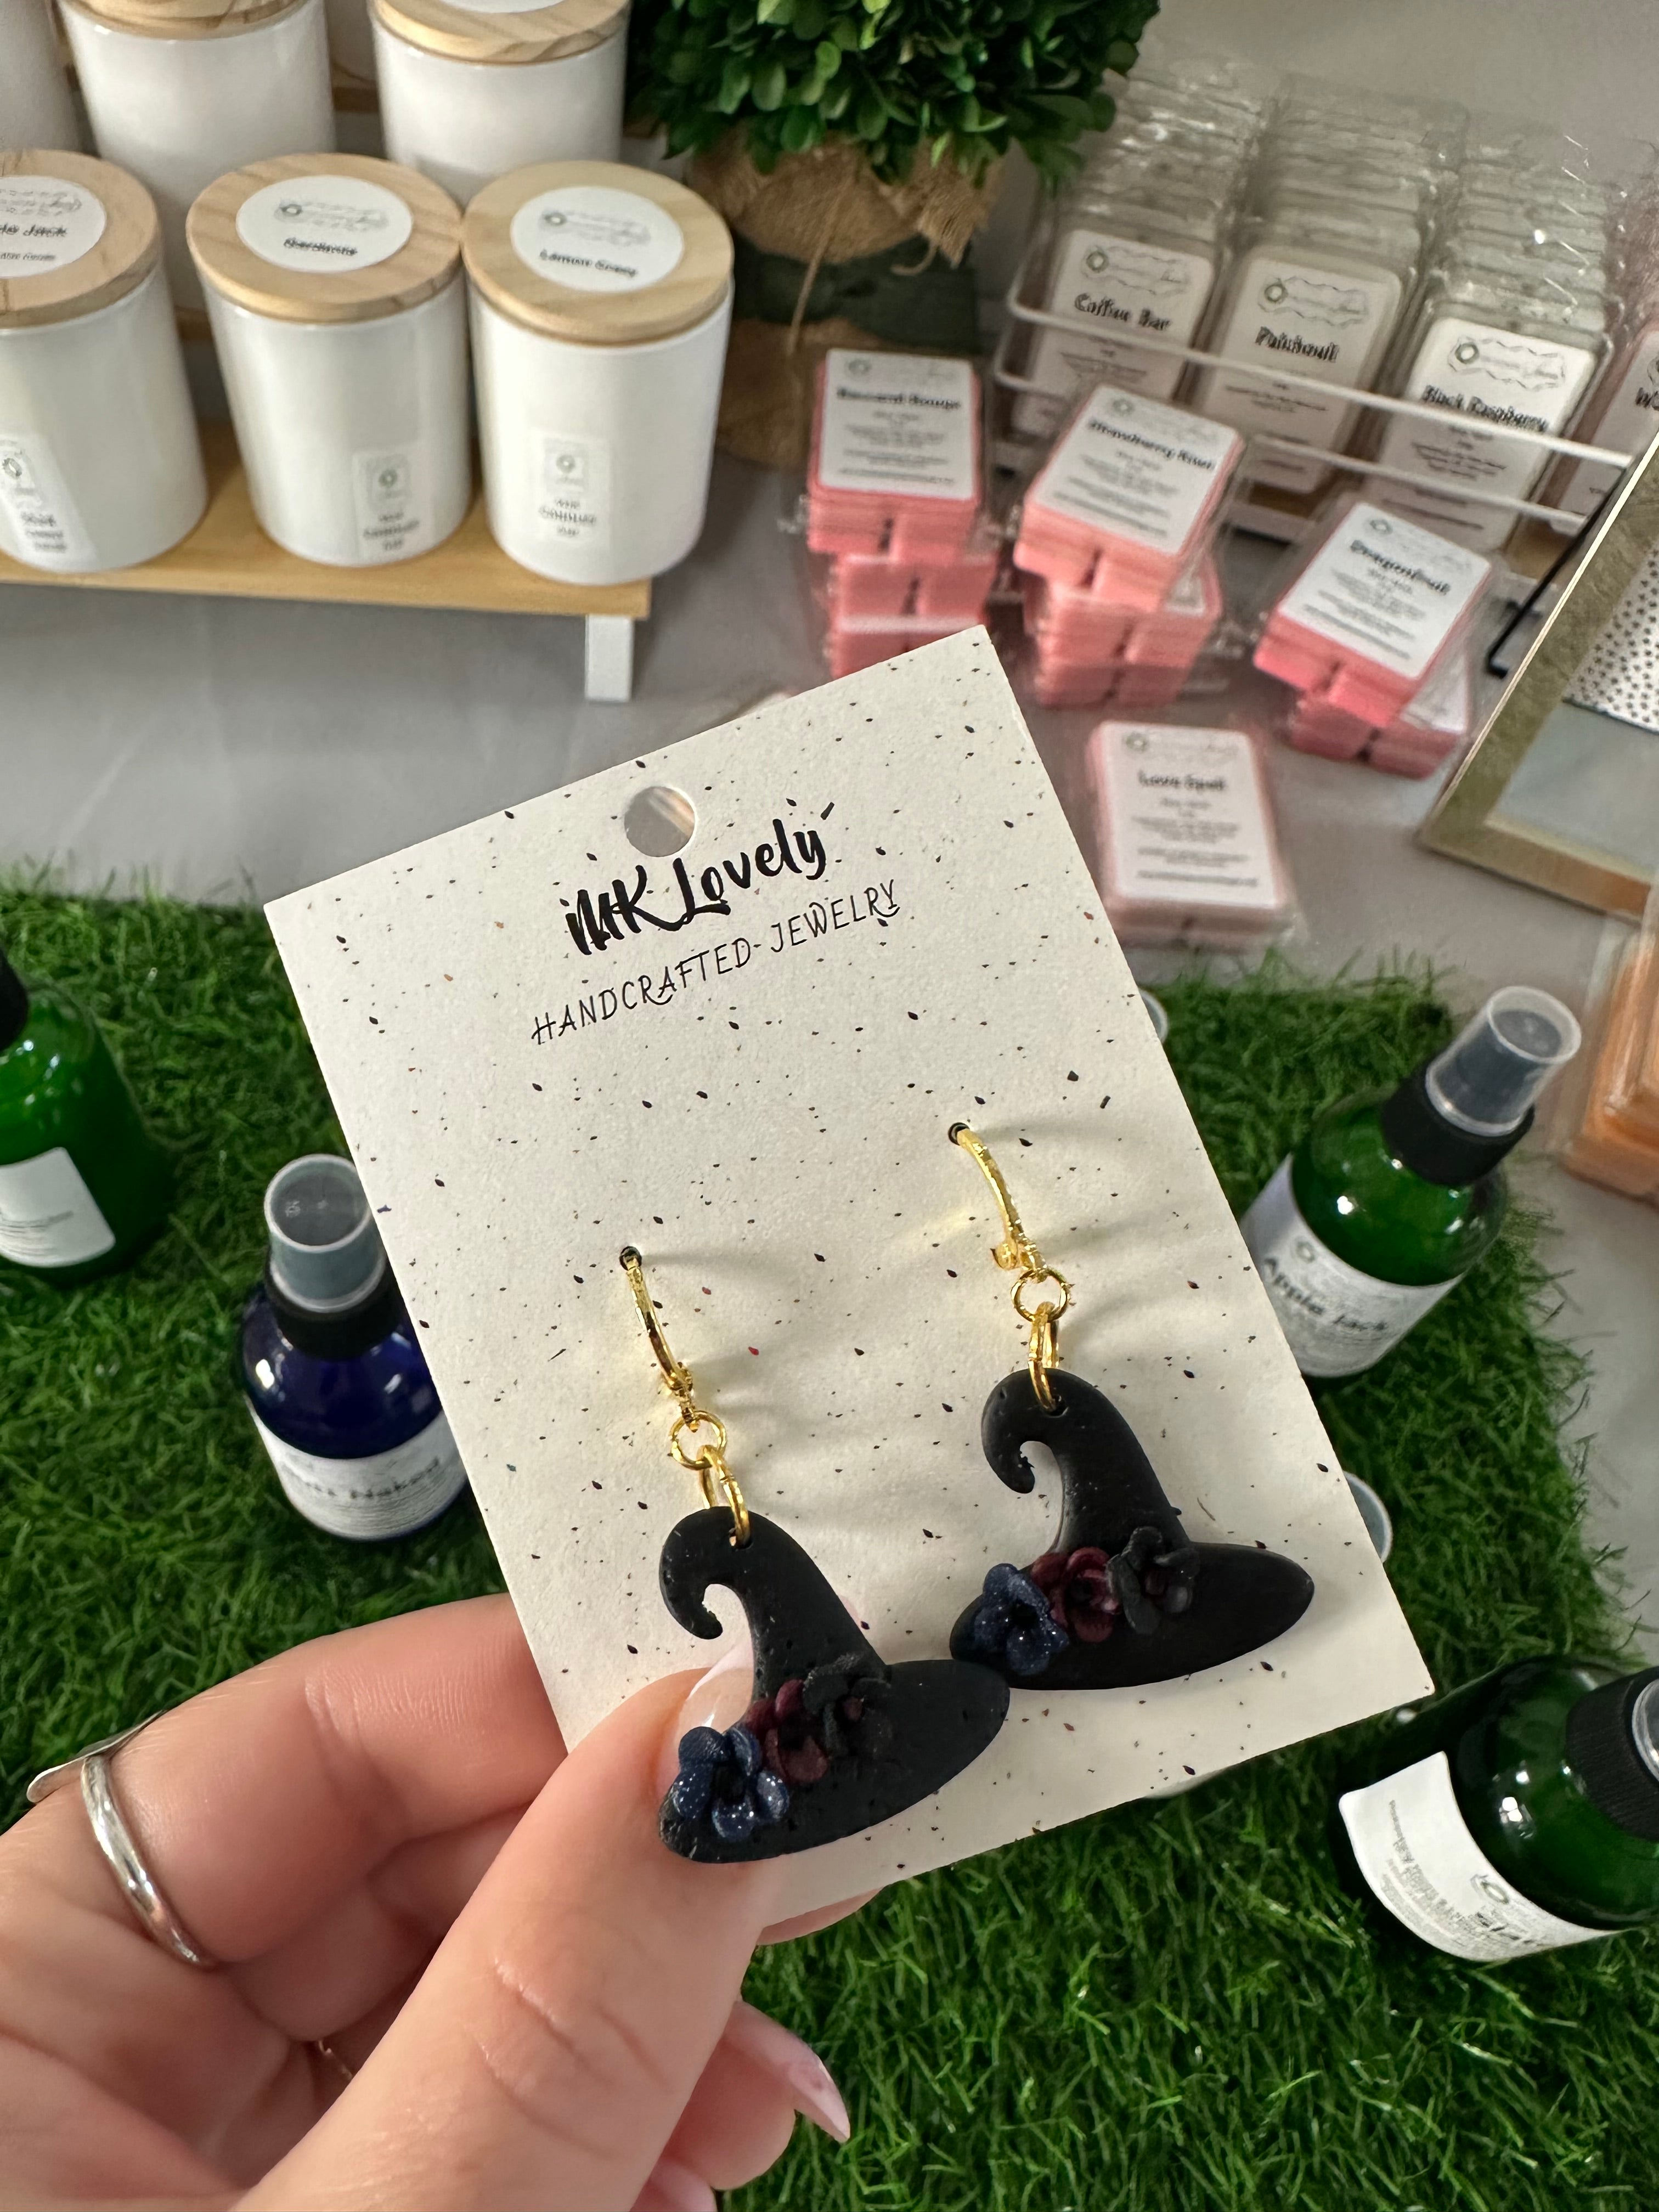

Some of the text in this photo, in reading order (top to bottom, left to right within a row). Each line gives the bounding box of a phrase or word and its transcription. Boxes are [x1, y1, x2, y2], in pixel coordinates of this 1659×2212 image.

[673, 816, 827, 925] Lovely
[531, 879, 901, 1045] HANDCRAFTED JEWELRY
